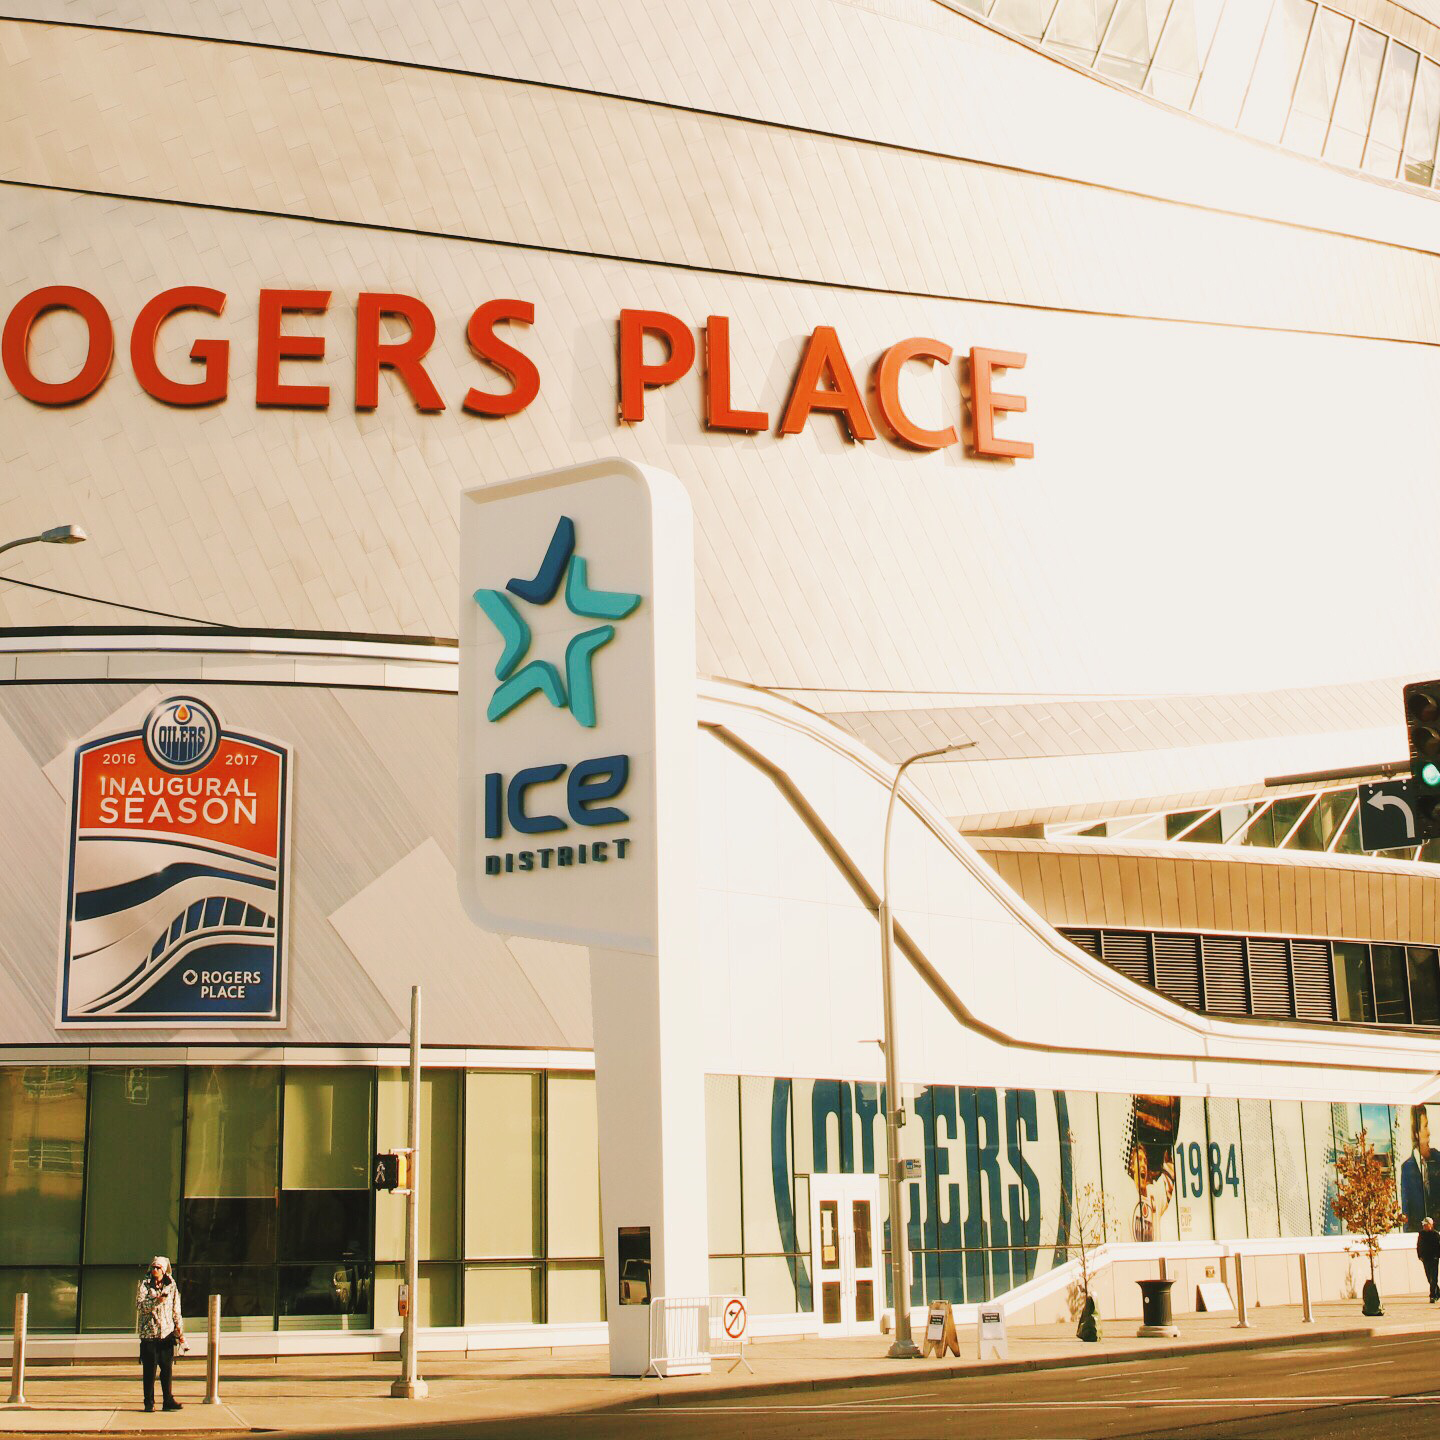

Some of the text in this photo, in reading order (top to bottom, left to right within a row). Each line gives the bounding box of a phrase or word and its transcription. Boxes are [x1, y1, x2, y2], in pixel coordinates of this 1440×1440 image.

[618, 307, 1036, 460] PLACE
[158, 725, 207, 760] OILERS
[102, 753, 259, 766] 2016 2017
[100, 777, 257, 797] INAUGURAL
[98, 797, 257, 825] SEASON
[485, 838, 631, 875] DISTRICT
[200, 985, 246, 999] PLACE
[201, 971, 261, 984] ROGERS
[1176, 1141, 1240, 1198] 1984
[812, 1076, 1042, 1306] OIERS
